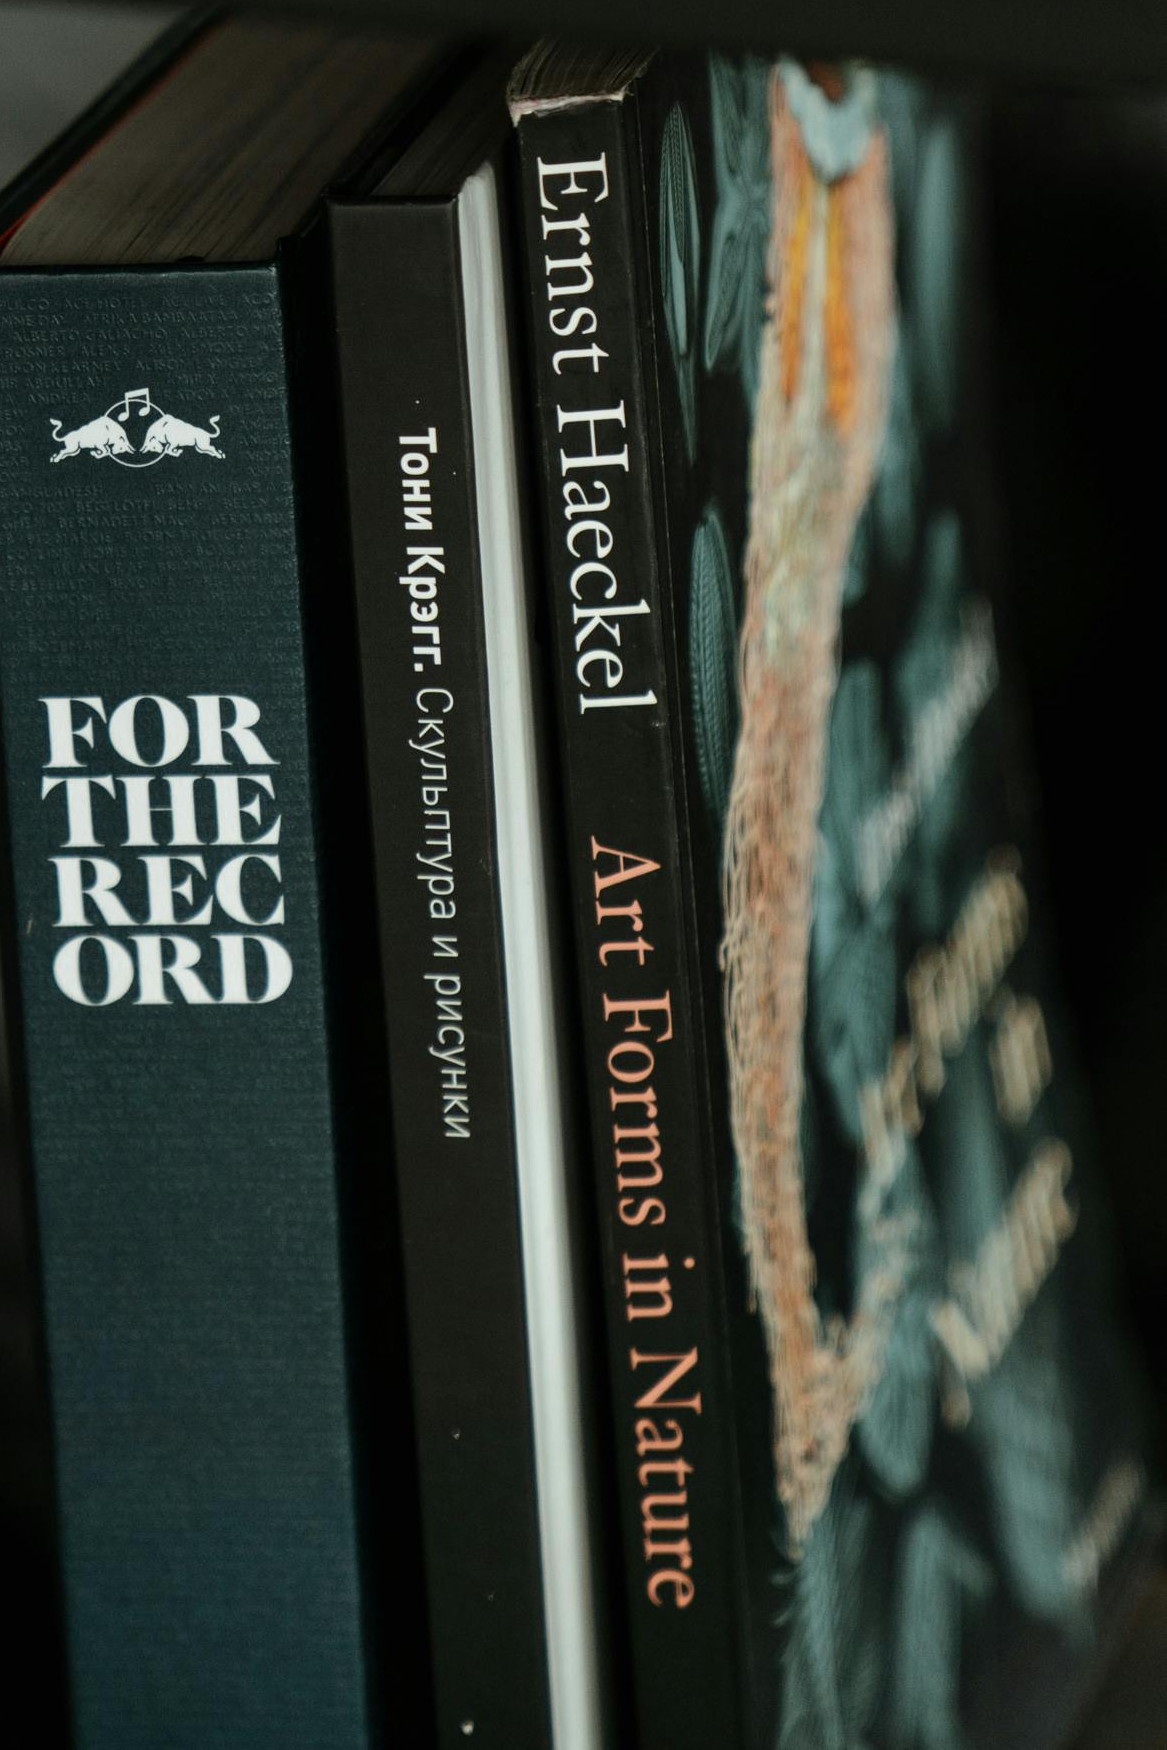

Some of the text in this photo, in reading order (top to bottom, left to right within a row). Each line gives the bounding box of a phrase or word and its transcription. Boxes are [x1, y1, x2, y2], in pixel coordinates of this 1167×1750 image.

[536, 151, 658, 715] Ernst Haeckel
[37, 694, 281, 769] FOR
[40, 773, 282, 848] THE
[398, 426, 471, 1139] Тони Крэгг. Скульптура и рисунки
[47, 852, 286, 928] REC
[52, 933, 294, 1007] ORD
[590, 835, 701, 1608] Art Forms in Nature
